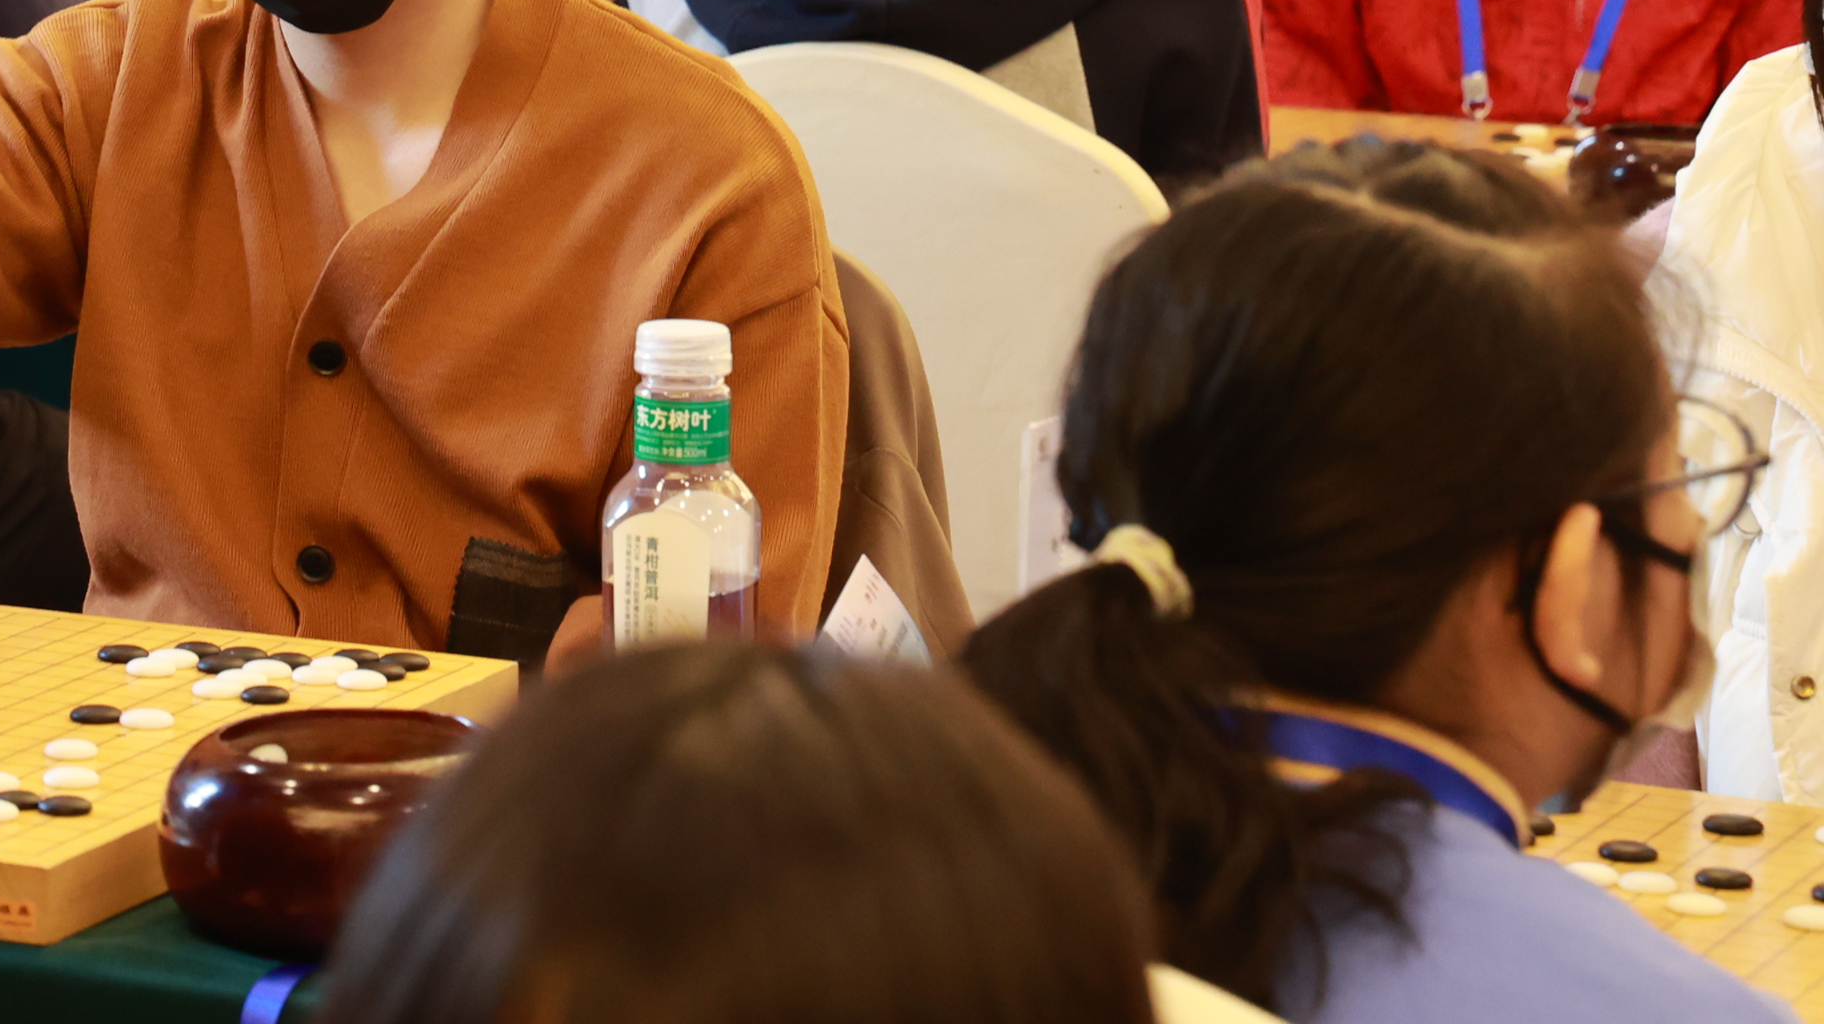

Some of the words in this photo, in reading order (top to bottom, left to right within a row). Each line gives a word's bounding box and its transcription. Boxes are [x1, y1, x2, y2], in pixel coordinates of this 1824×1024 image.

[636, 404, 712, 432] 东方树叶
[645, 536, 659, 602] 青柑普洱
